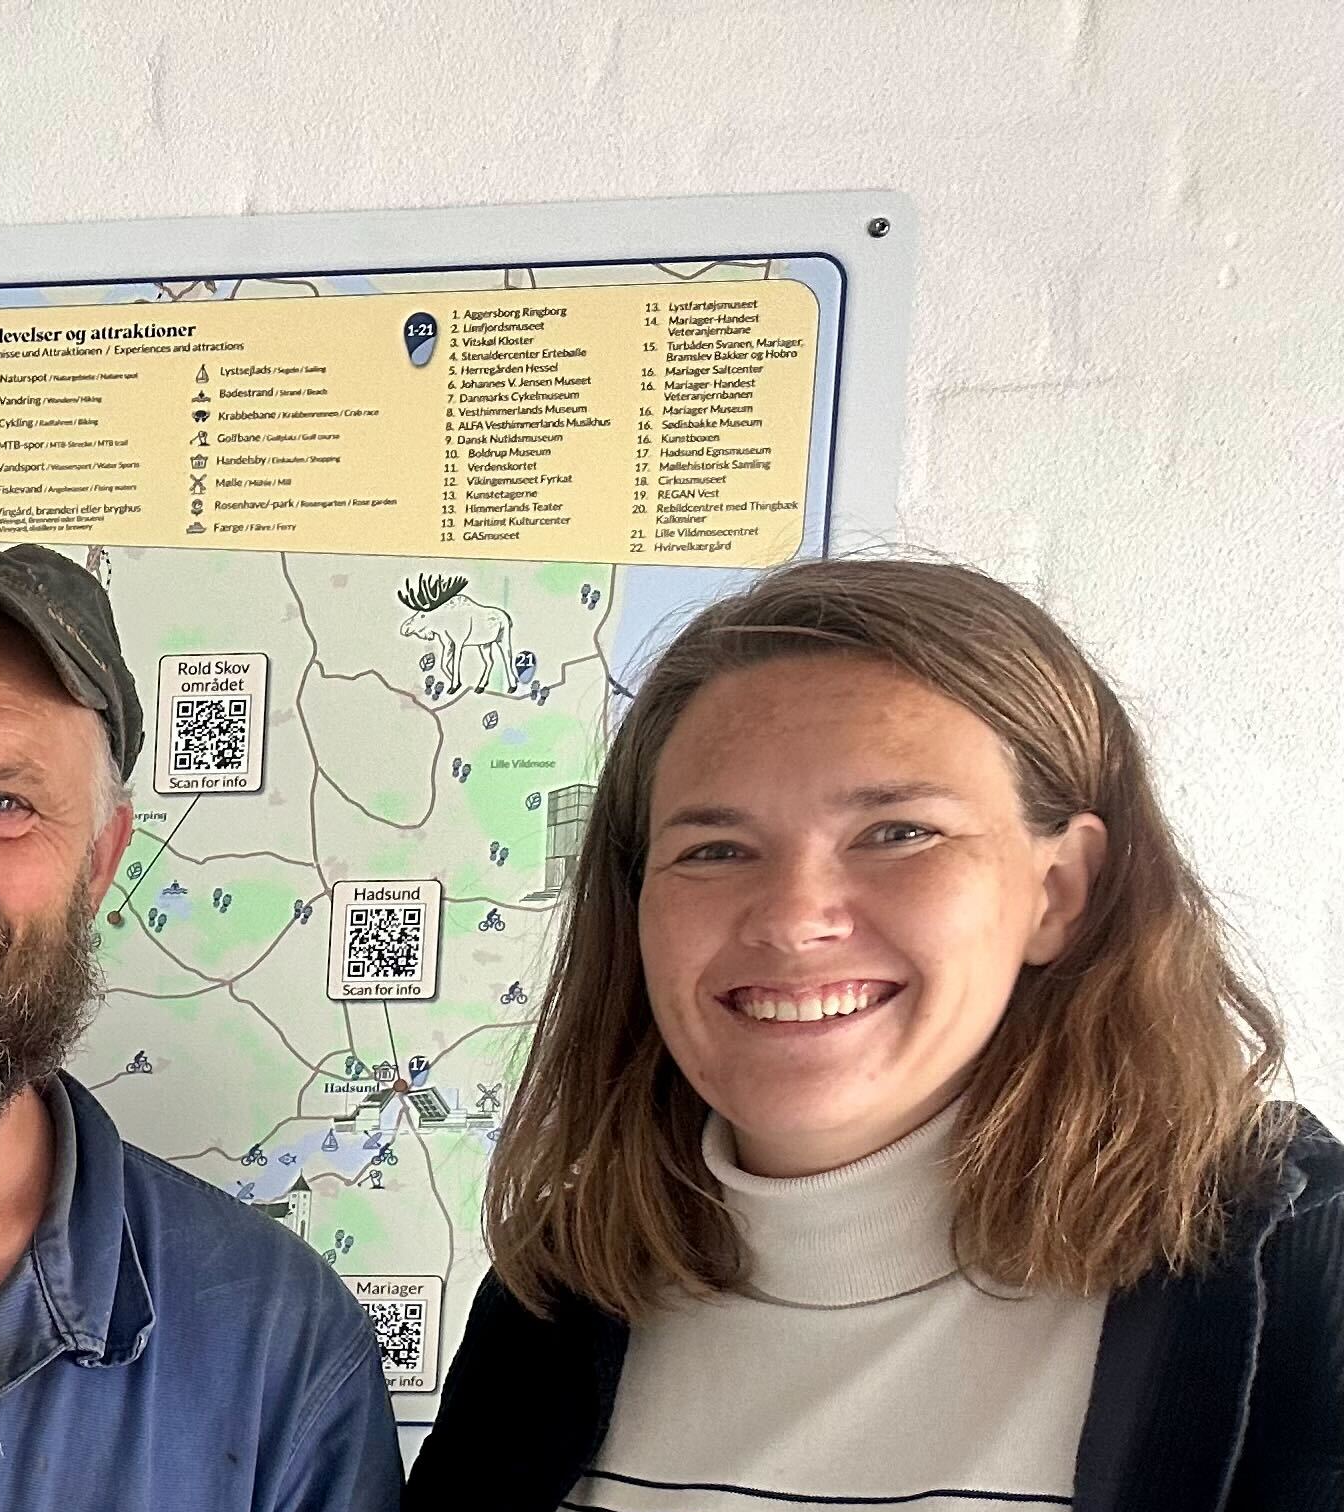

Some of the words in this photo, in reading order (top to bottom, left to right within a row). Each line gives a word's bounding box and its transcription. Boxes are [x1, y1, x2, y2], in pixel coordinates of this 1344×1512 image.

[65, 329, 86, 345] og
[90, 322, 196, 340] attraktioner
[407, 323, 434, 337] 1-21
[450, 323, 459, 334] 2.
[463, 321, 544, 334] Limfjordsmuseet
[21, 347, 40, 358] und
[41, 346, 102, 357] Attraktionen
[114, 344, 171, 356] Experiences
[172, 342, 190, 353] and
[191, 341, 244, 352] attractions
[0, 373, 48, 384] Naturspot
[218, 387, 274, 398] Badestrand
[633, 490, 646, 500] 19.
[657, 488, 695, 500] REGAN
[697, 488, 719, 498] Vest
[441, 504, 456, 514] 13.
[465, 502, 530, 513] Himmerlands
[532, 502, 563, 511] Teater
[517, 654, 534, 667] 21
[178, 661, 211, 675] Rold
[214, 660, 250, 675] Skov
[181, 677, 244, 692] området
[169, 777, 198, 789] Scan
[201, 776, 220, 788] for
[222, 775, 247, 787] info
[354, 886, 420, 901] Hadsund
[342, 984, 372, 996] Scan
[374, 983, 393, 995] for
[396, 983, 421, 995] info
[411, 1058, 427, 1070] 17
[324, 1082, 383, 1094] Hadsund
[356, 1281, 424, 1297] Mariager
[399, 1375, 424, 1387] info
